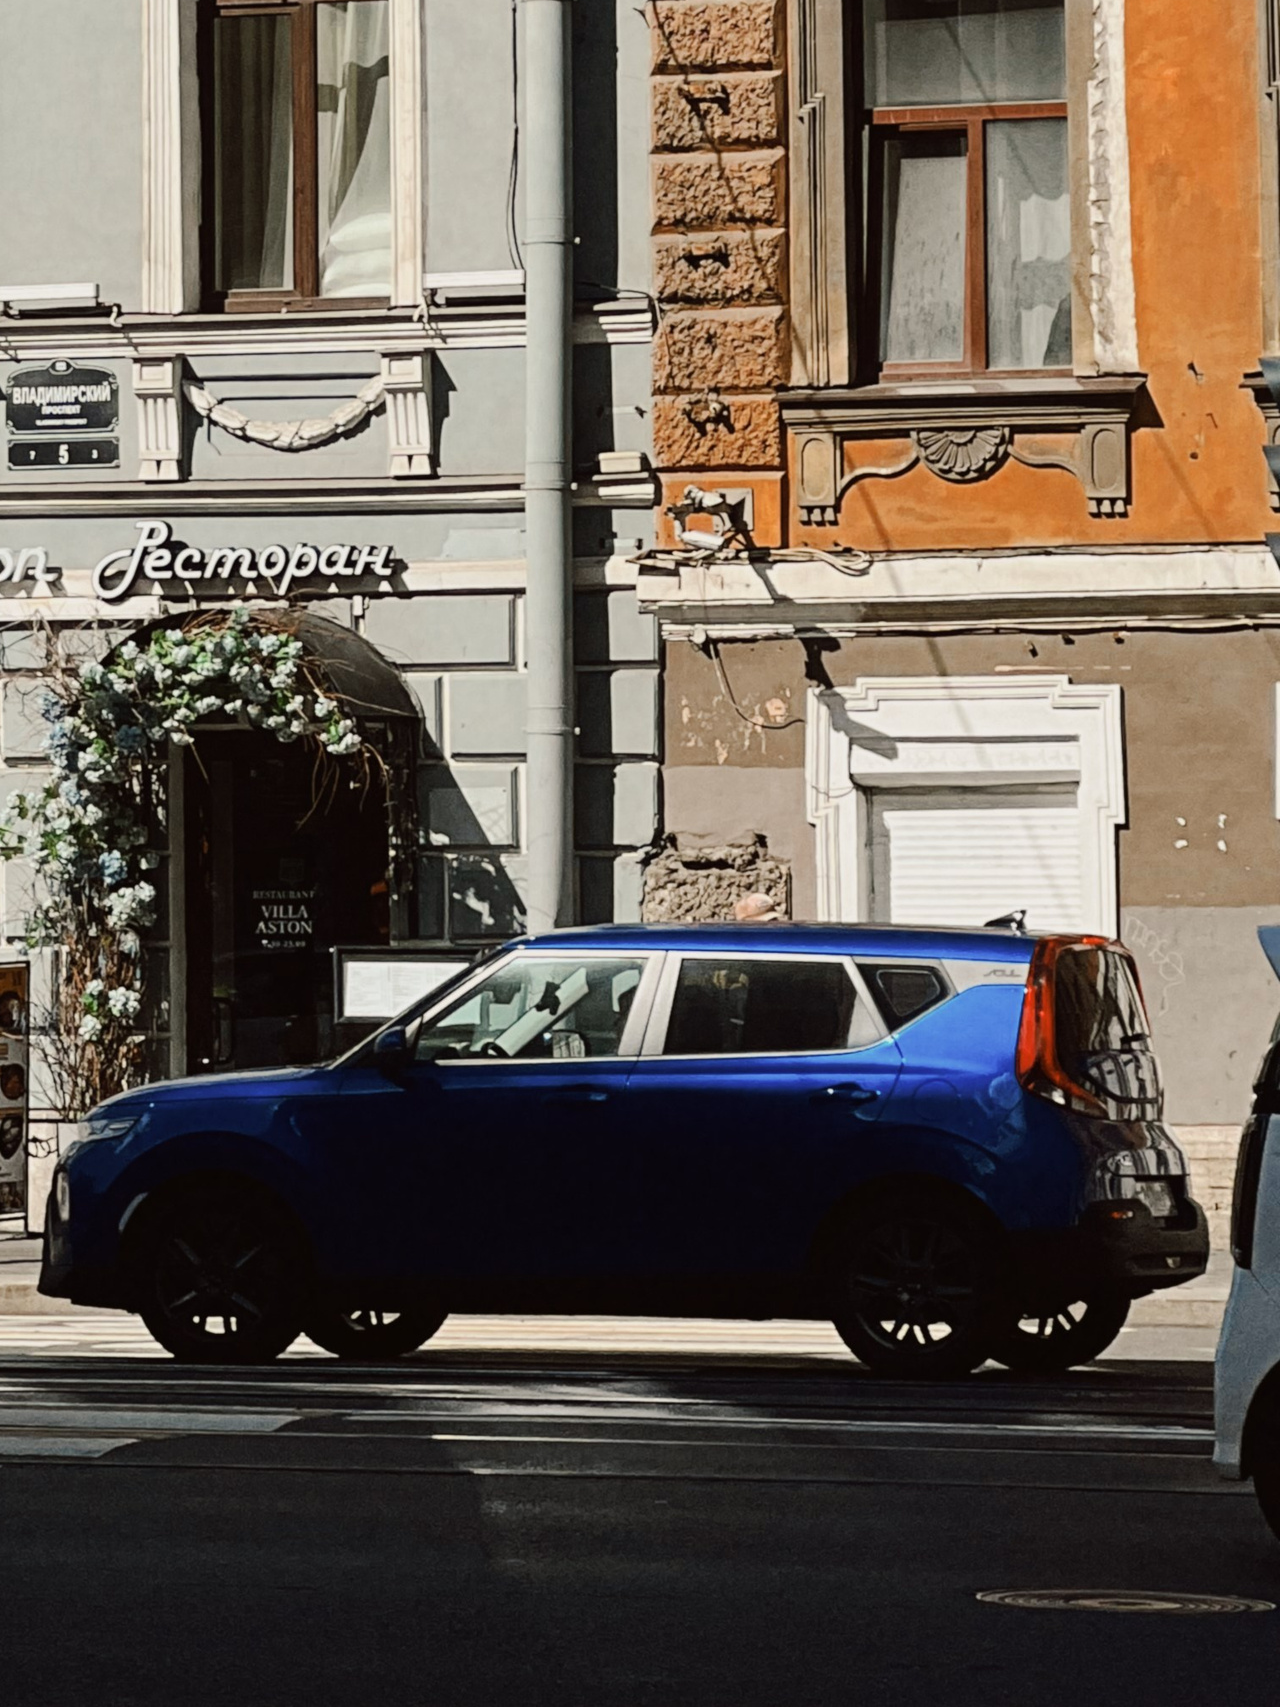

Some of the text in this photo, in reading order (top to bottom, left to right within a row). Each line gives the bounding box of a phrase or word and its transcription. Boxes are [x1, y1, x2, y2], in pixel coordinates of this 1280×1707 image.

[12, 381, 111, 406] ВЛАДИМИРСКИЙ
[58, 443, 69, 464] 5
[91, 519, 395, 599] Ресторан
[261, 904, 308, 919] VILLA
[255, 920, 313, 934] ASTON
